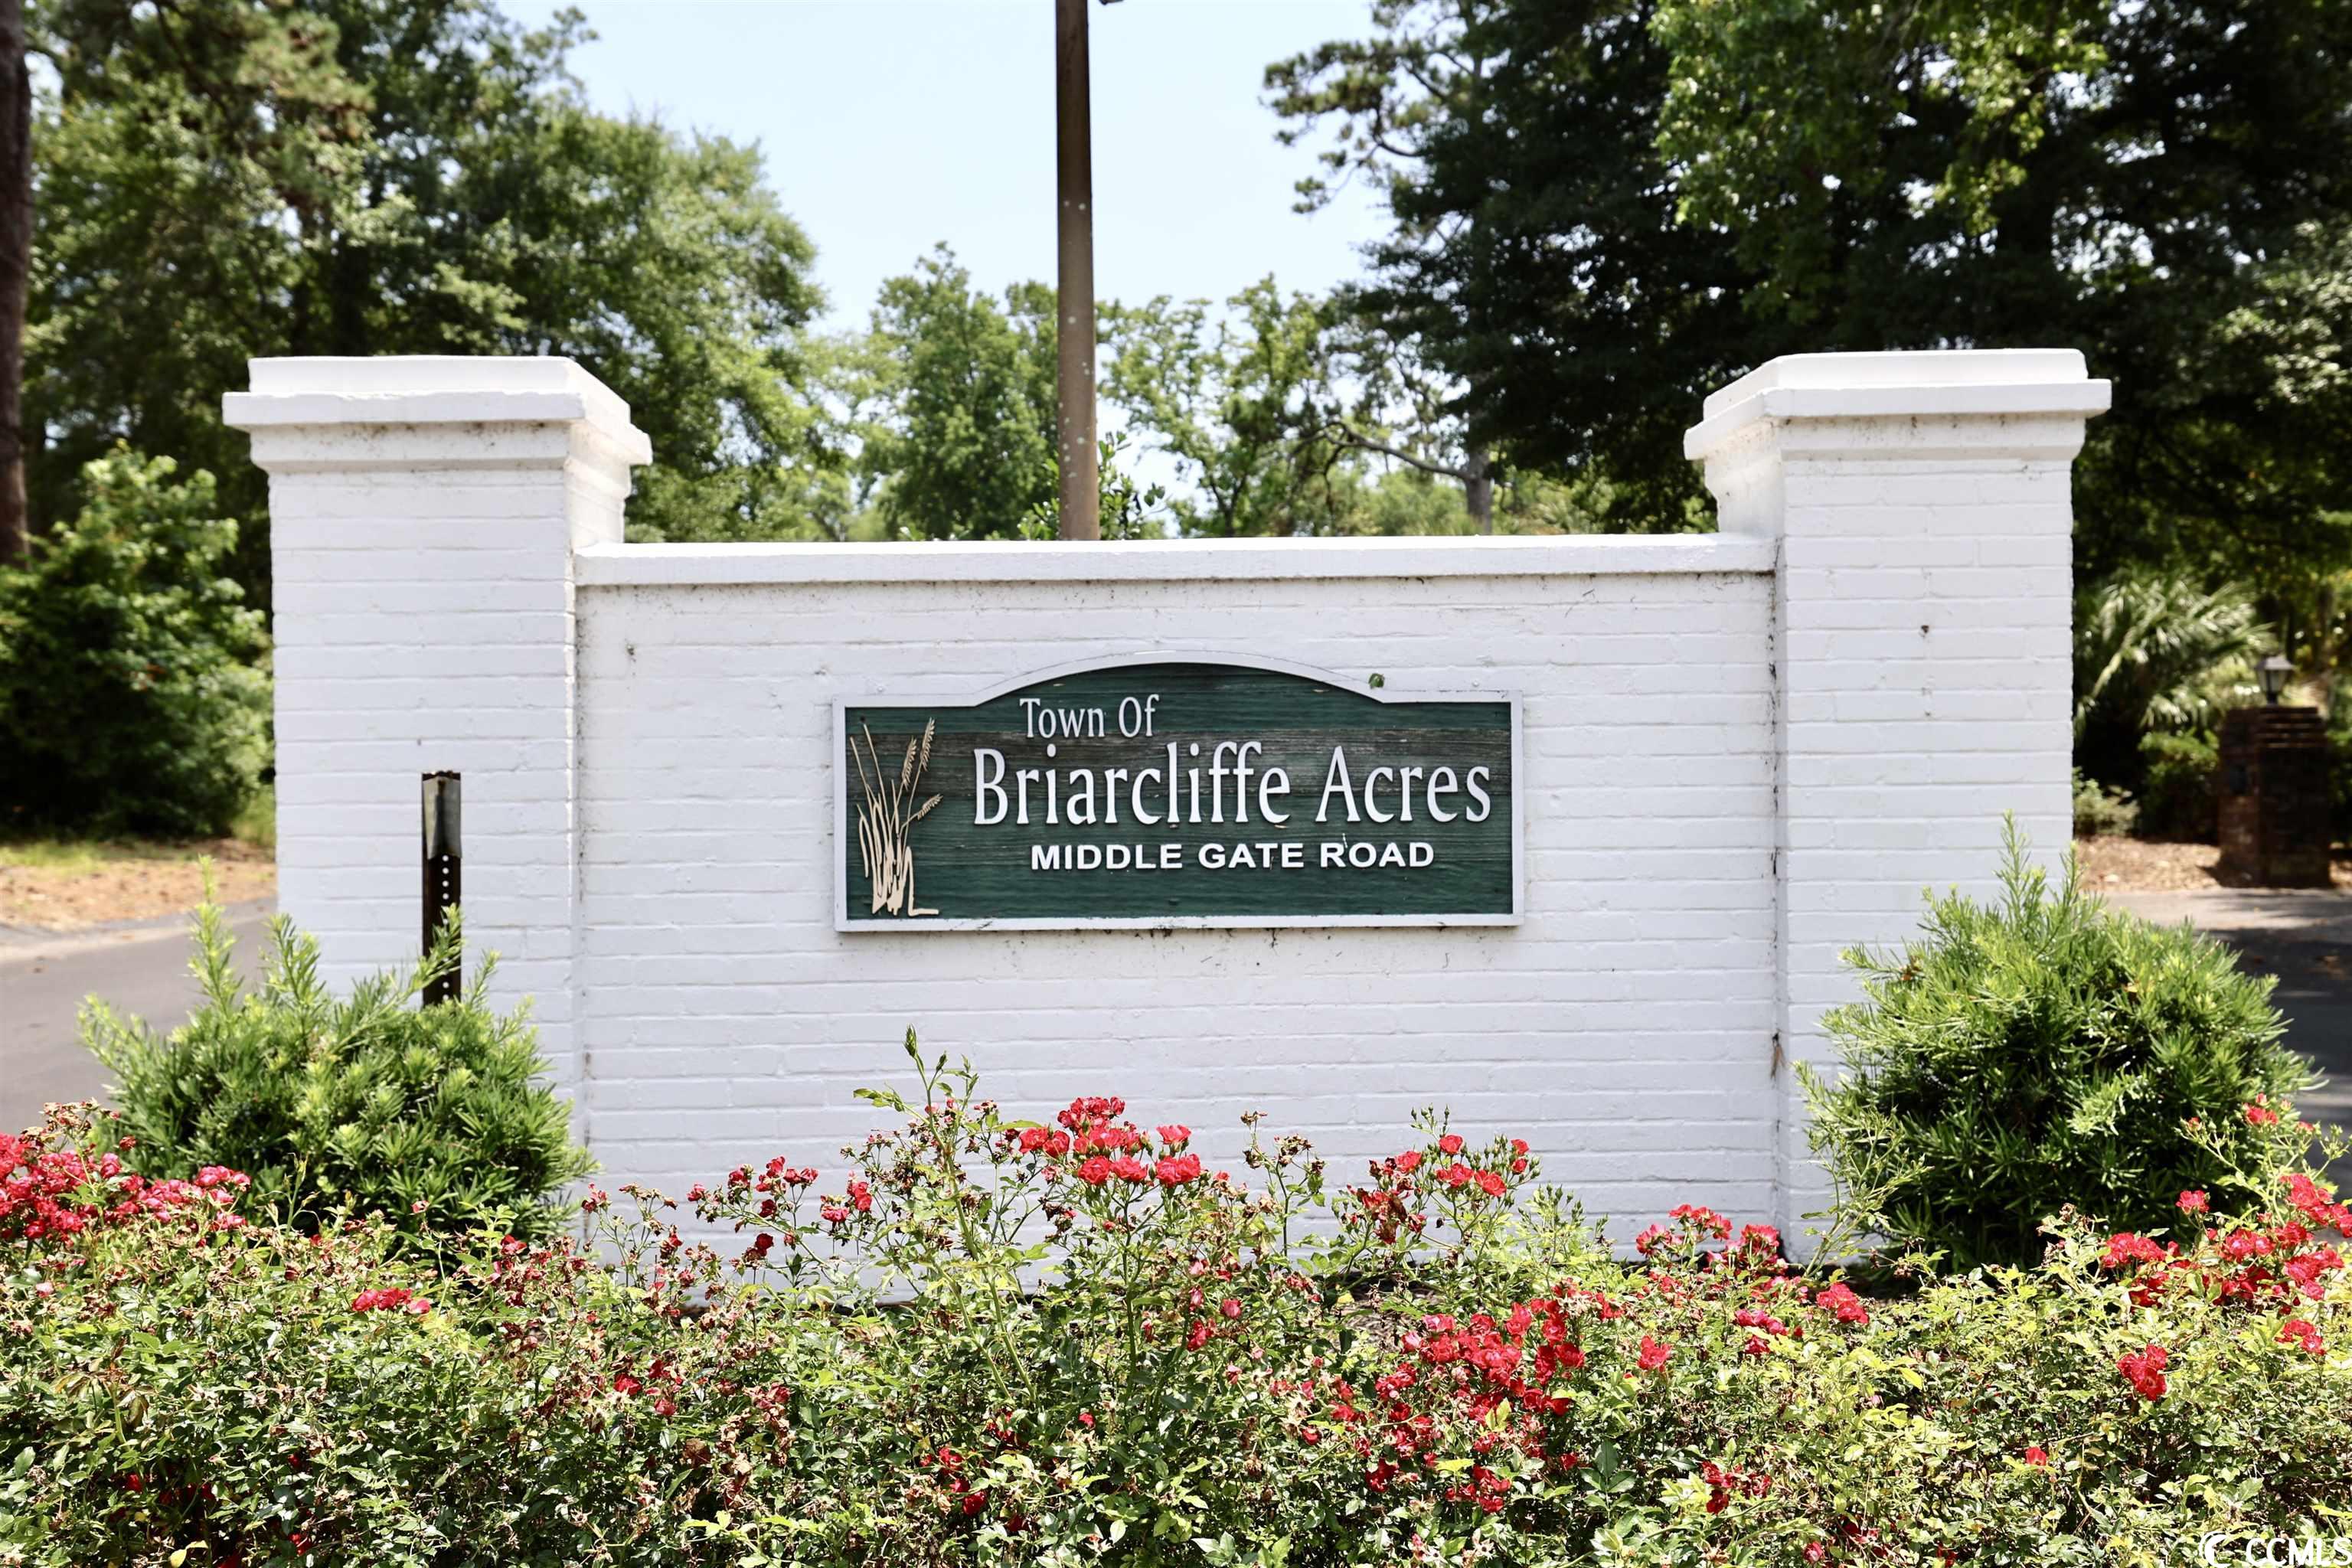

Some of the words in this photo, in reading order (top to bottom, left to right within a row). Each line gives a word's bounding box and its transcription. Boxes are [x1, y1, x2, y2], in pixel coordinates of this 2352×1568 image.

[1018, 697, 1106, 739] Town
[1118, 694, 1160, 737] Of
[973, 740, 1291, 825] Briarcliffe
[1315, 745, 1491, 824] Acres
[1031, 843, 1184, 871] MIDDLE
[1198, 842, 1305, 869] GATE
[1320, 841, 1435, 868] ROAD
